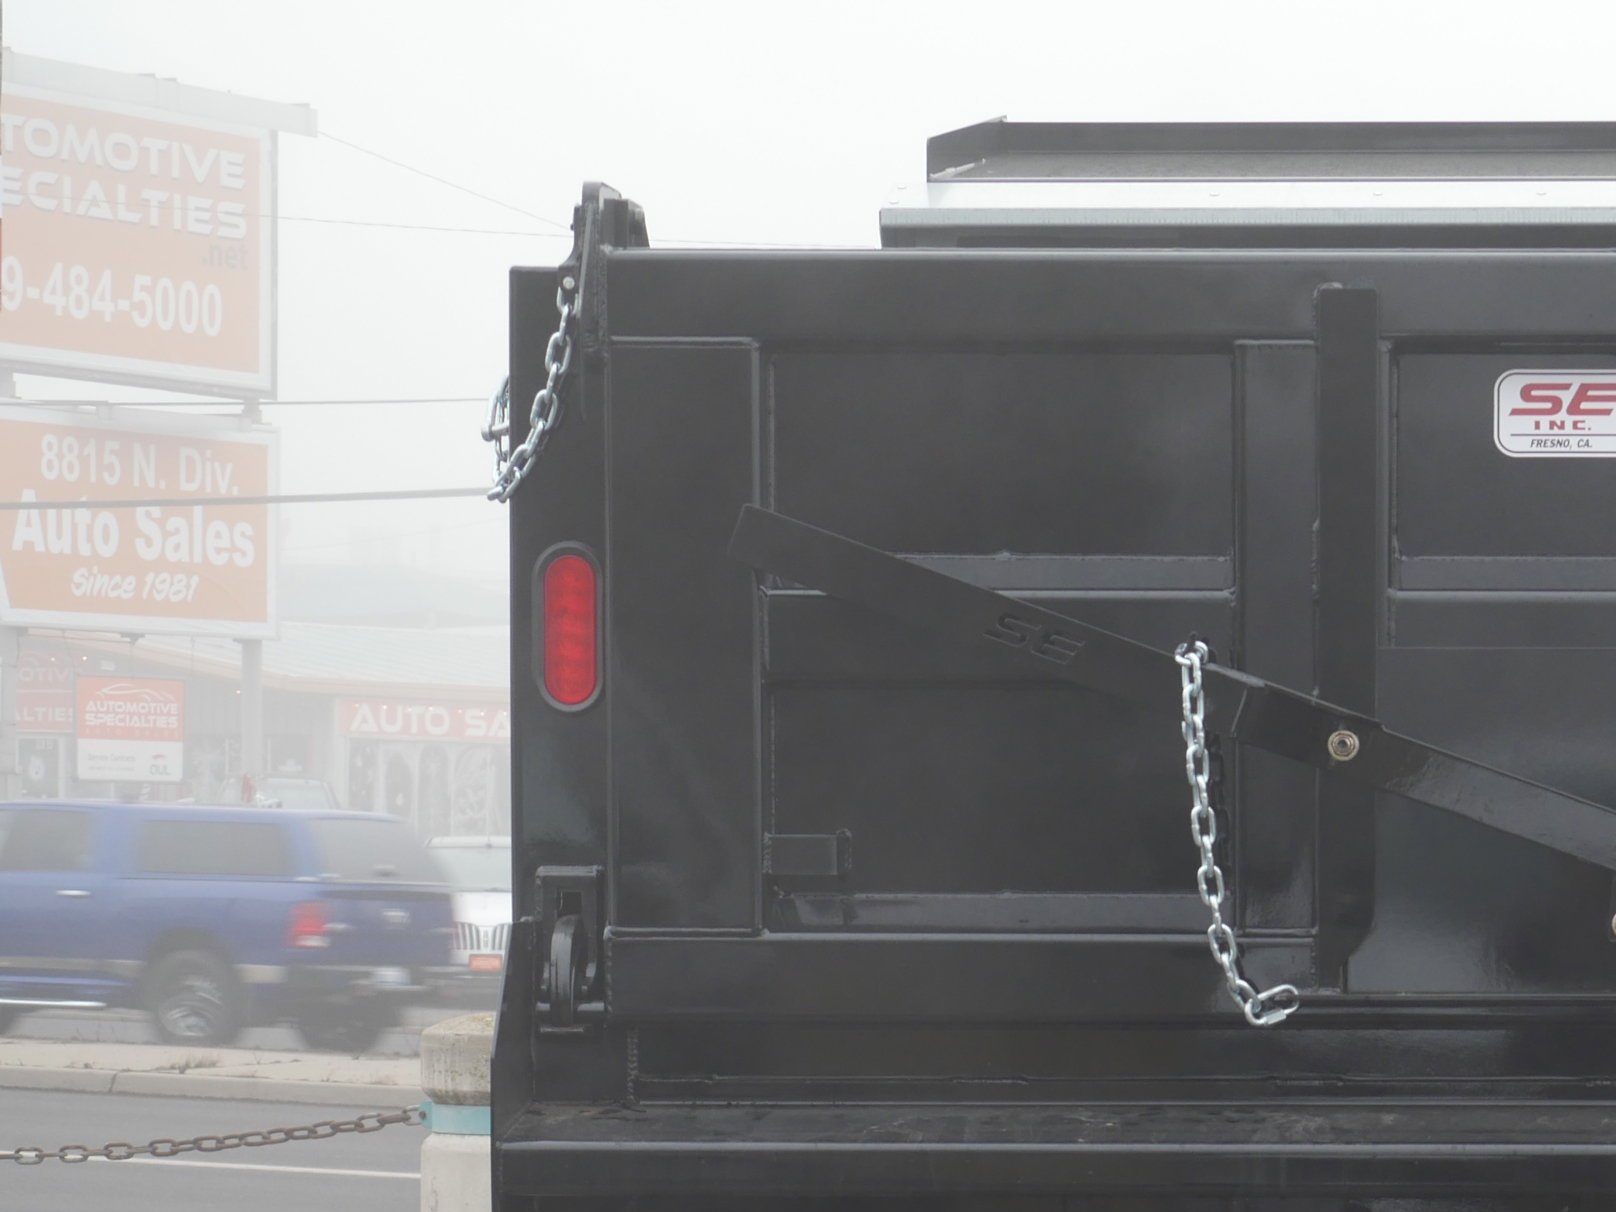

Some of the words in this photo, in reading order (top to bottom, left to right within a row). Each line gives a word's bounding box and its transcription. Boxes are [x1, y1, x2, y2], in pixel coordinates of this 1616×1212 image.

[2, 255, 223, 337] 9-484-5000
[1534, 420, 1592, 431] INC.
[1530, 438, 1572, 450] FRESNO,
[1577, 438, 1593, 449] CA.
[41, 433, 121, 486] 8815
[133, 442, 166, 490] N.
[179, 447, 239, 496] Div.
[11, 488, 120, 558] Auto
[134, 499, 256, 568] Sales
[71, 566, 137, 600] Since
[142, 571, 200, 603] 1981
[85, 700, 179, 715] AUTOMOTIVE
[85, 713, 179, 729] SPECIALTIES
[349, 702, 451, 736] AUTO
